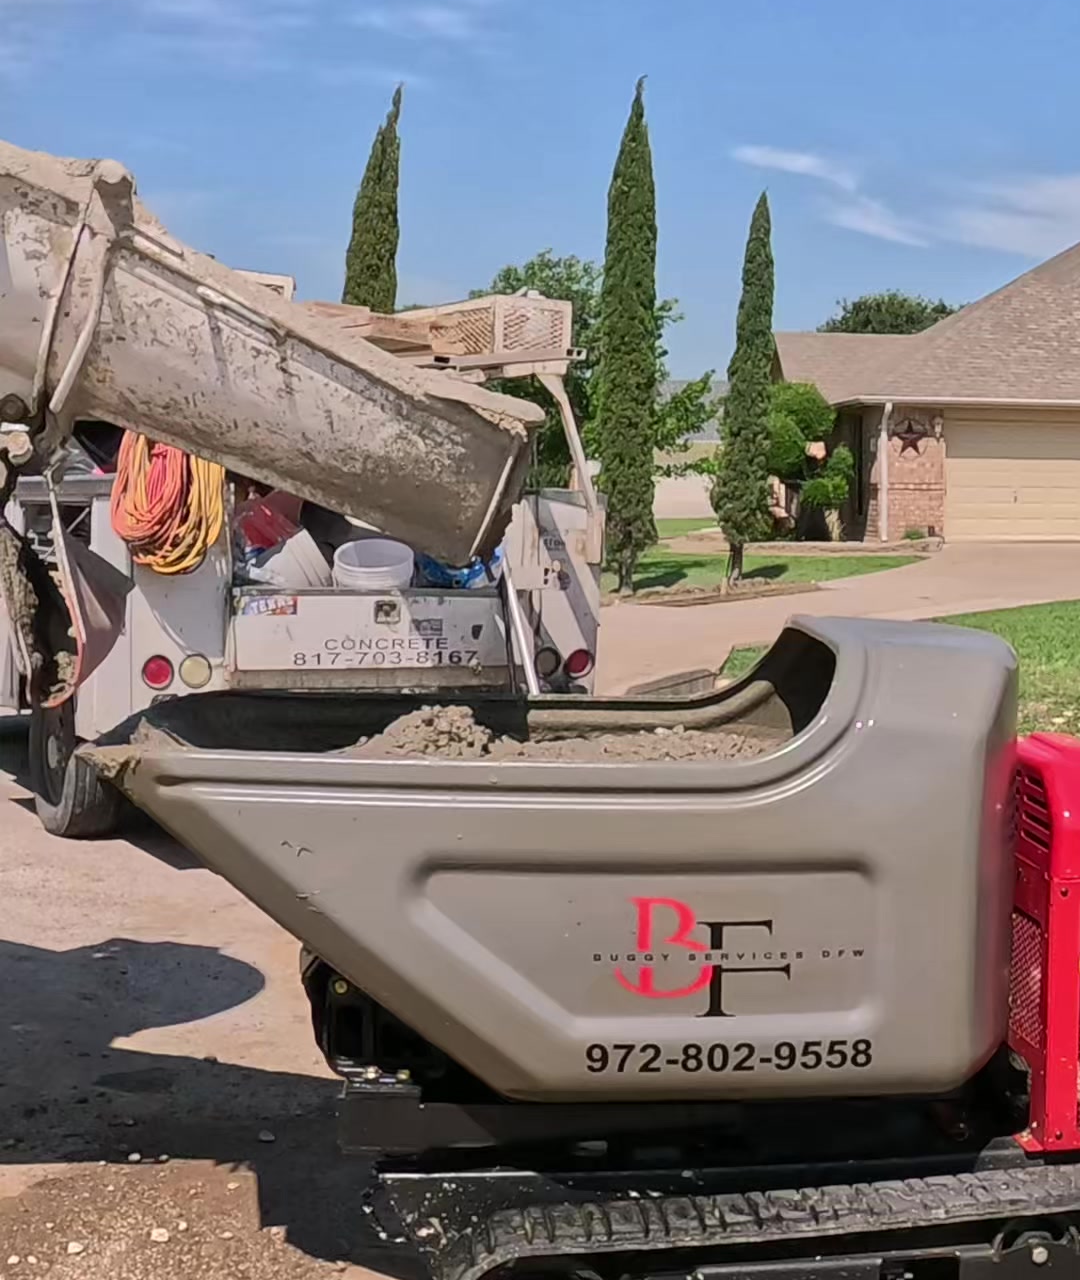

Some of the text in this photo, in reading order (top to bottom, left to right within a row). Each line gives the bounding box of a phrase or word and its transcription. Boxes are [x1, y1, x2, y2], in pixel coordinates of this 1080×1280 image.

[324, 638, 449, 651] CONCRETE
[293, 651, 478, 666] 817-703-8167
[593, 949, 865, 962] BUGGY SERVICES DFW
[585, 1038, 873, 1073] 972-802-9558
